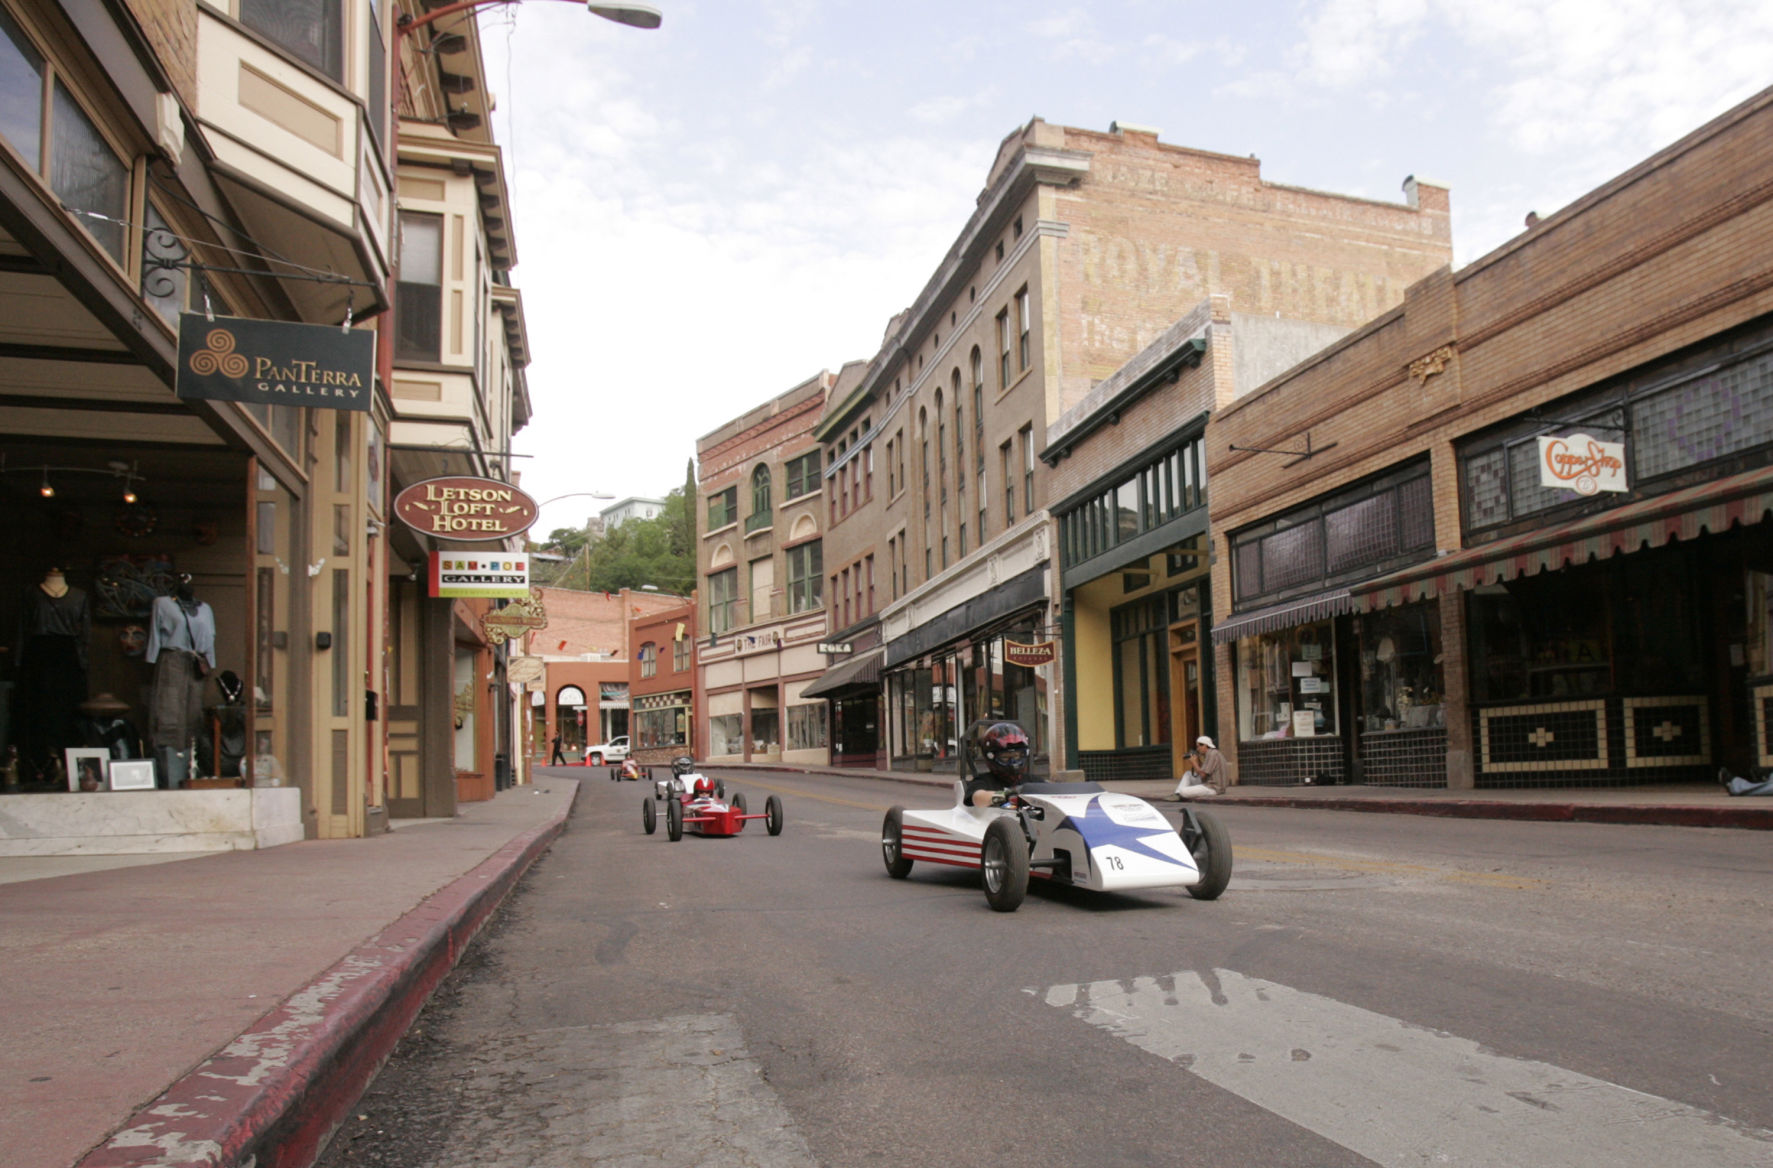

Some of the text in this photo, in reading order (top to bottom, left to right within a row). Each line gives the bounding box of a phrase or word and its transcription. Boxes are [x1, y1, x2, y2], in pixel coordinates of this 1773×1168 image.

[257, 382, 359, 398] GALLERY
[442, 560, 525, 571] SAM POE
[443, 575, 525, 583] GALLERY
[1010, 647, 1052, 656] BELLEZA
[1106, 856, 1124, 871] 78
